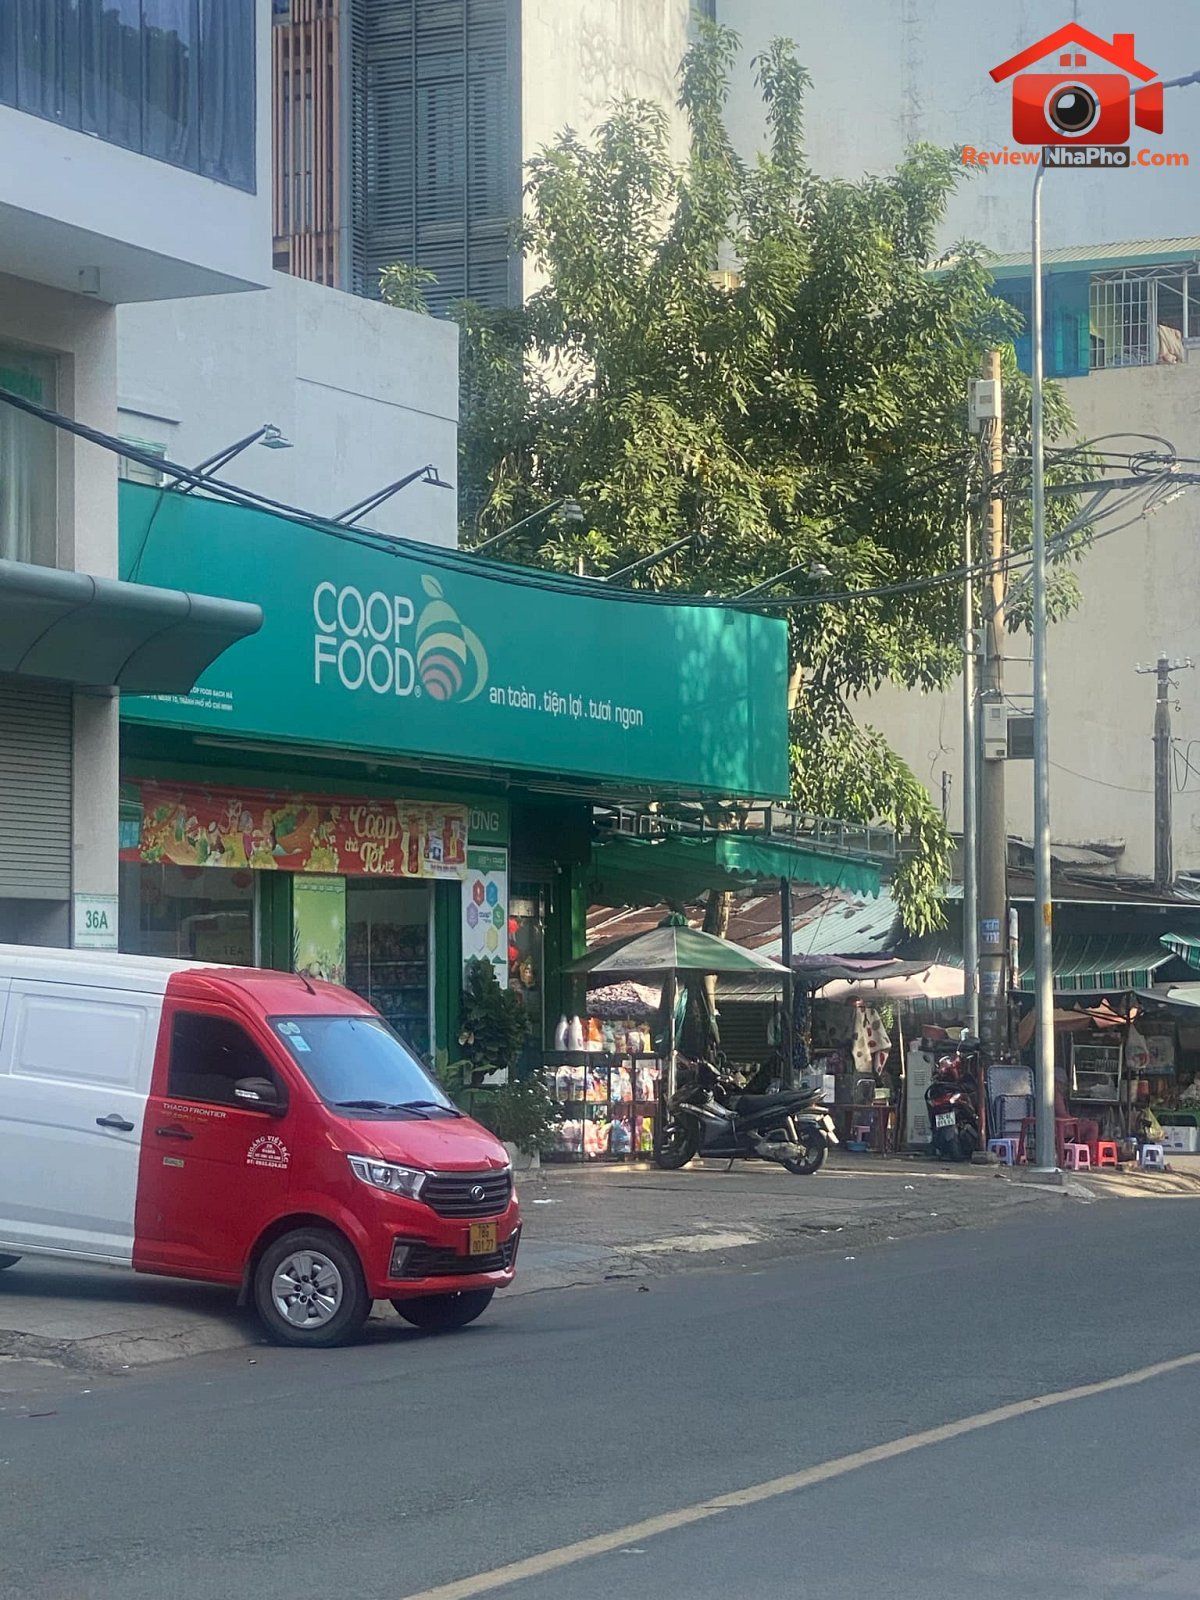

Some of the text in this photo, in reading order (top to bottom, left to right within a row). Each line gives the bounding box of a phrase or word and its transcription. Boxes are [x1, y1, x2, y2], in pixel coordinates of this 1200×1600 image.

[313, 581, 415, 643] CO.OP
[489, 687, 506, 705] an
[543, 690, 567, 717] tiện
[589, 699, 611, 721] tươi
[615, 706, 644, 730] ngon
[86, 910, 108, 929] 36A
[162, 1102, 189, 1112] THACO
[189, 1107, 227, 1118] FRONTIER
